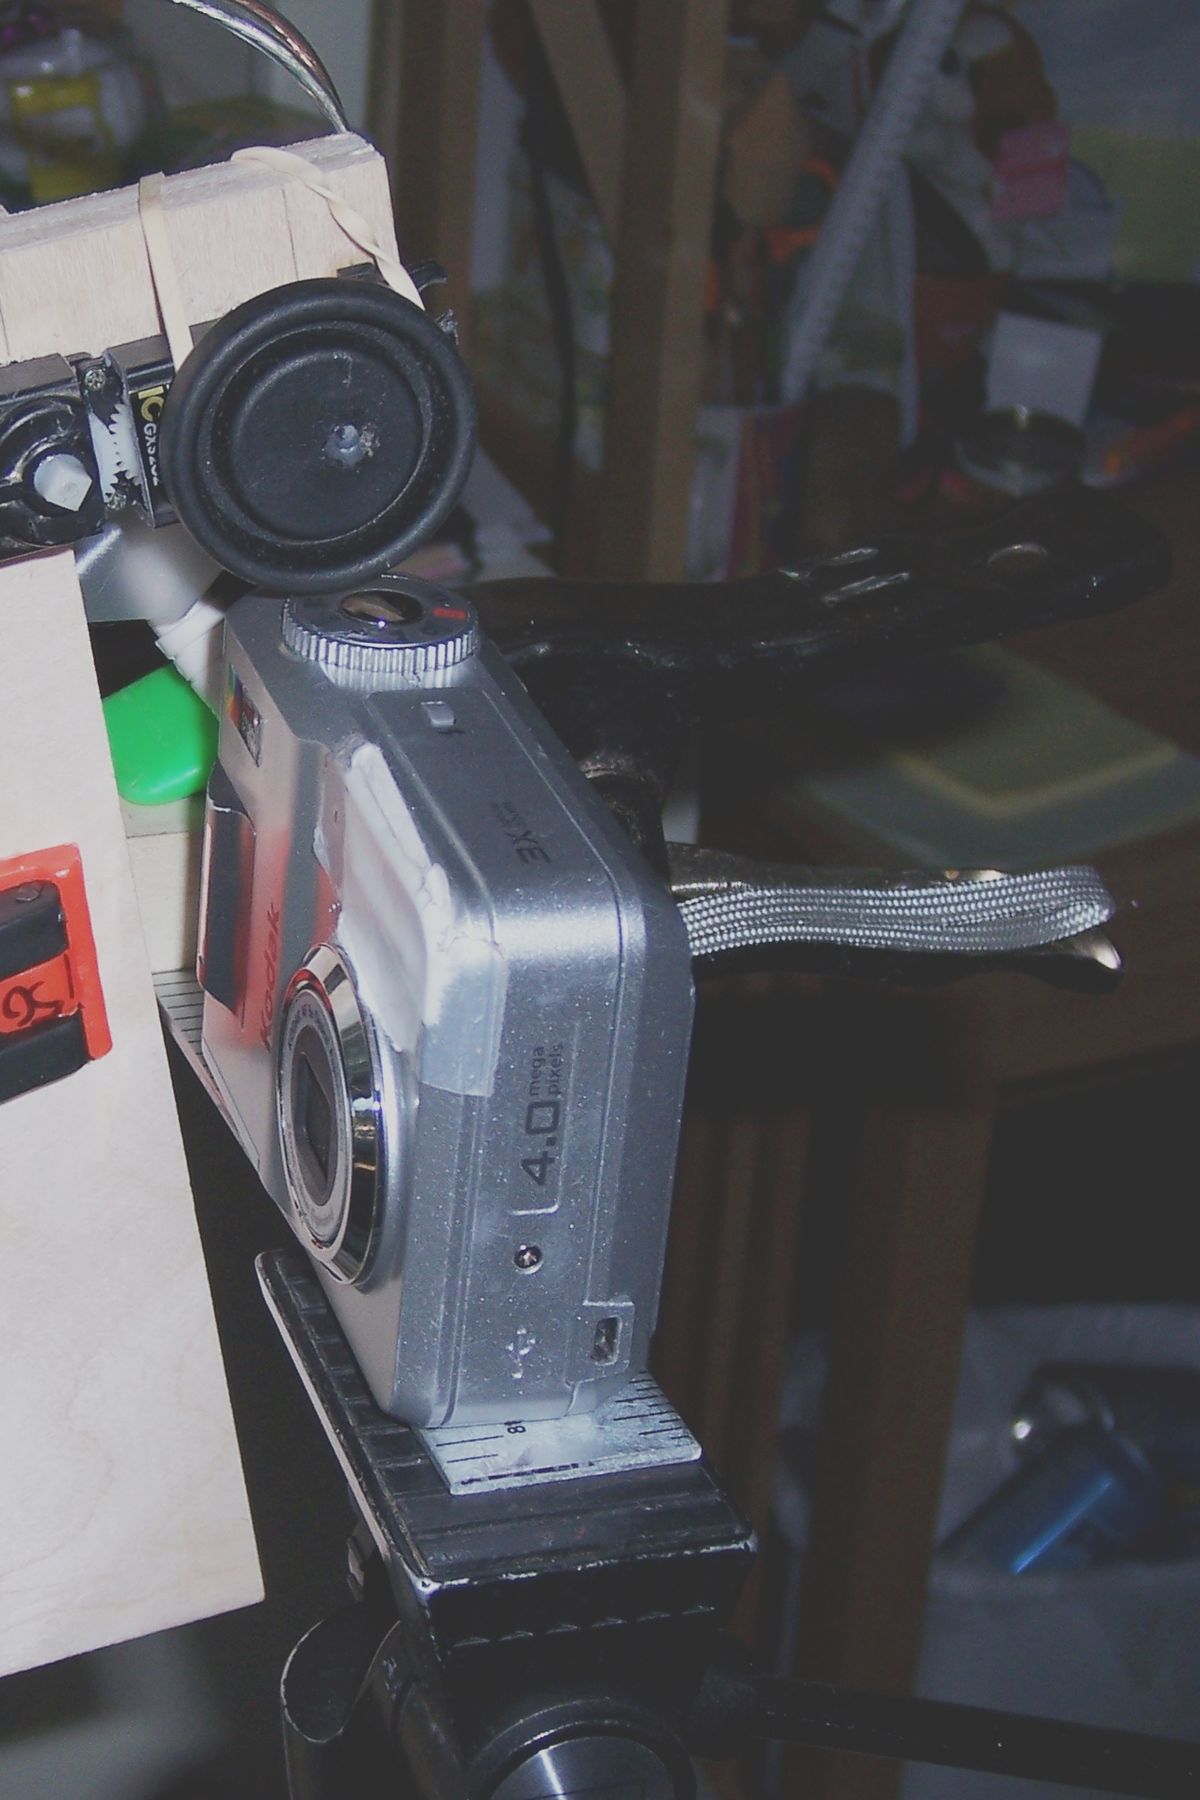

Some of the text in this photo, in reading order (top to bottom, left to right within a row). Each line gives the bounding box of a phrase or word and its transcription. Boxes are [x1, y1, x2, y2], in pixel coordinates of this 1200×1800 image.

[260, 902, 280, 1053] Kodak
[529, 1046, 546, 1097] mega
[548, 1043, 564, 1096] pixels
[520, 1100, 561, 1186] 4.0
